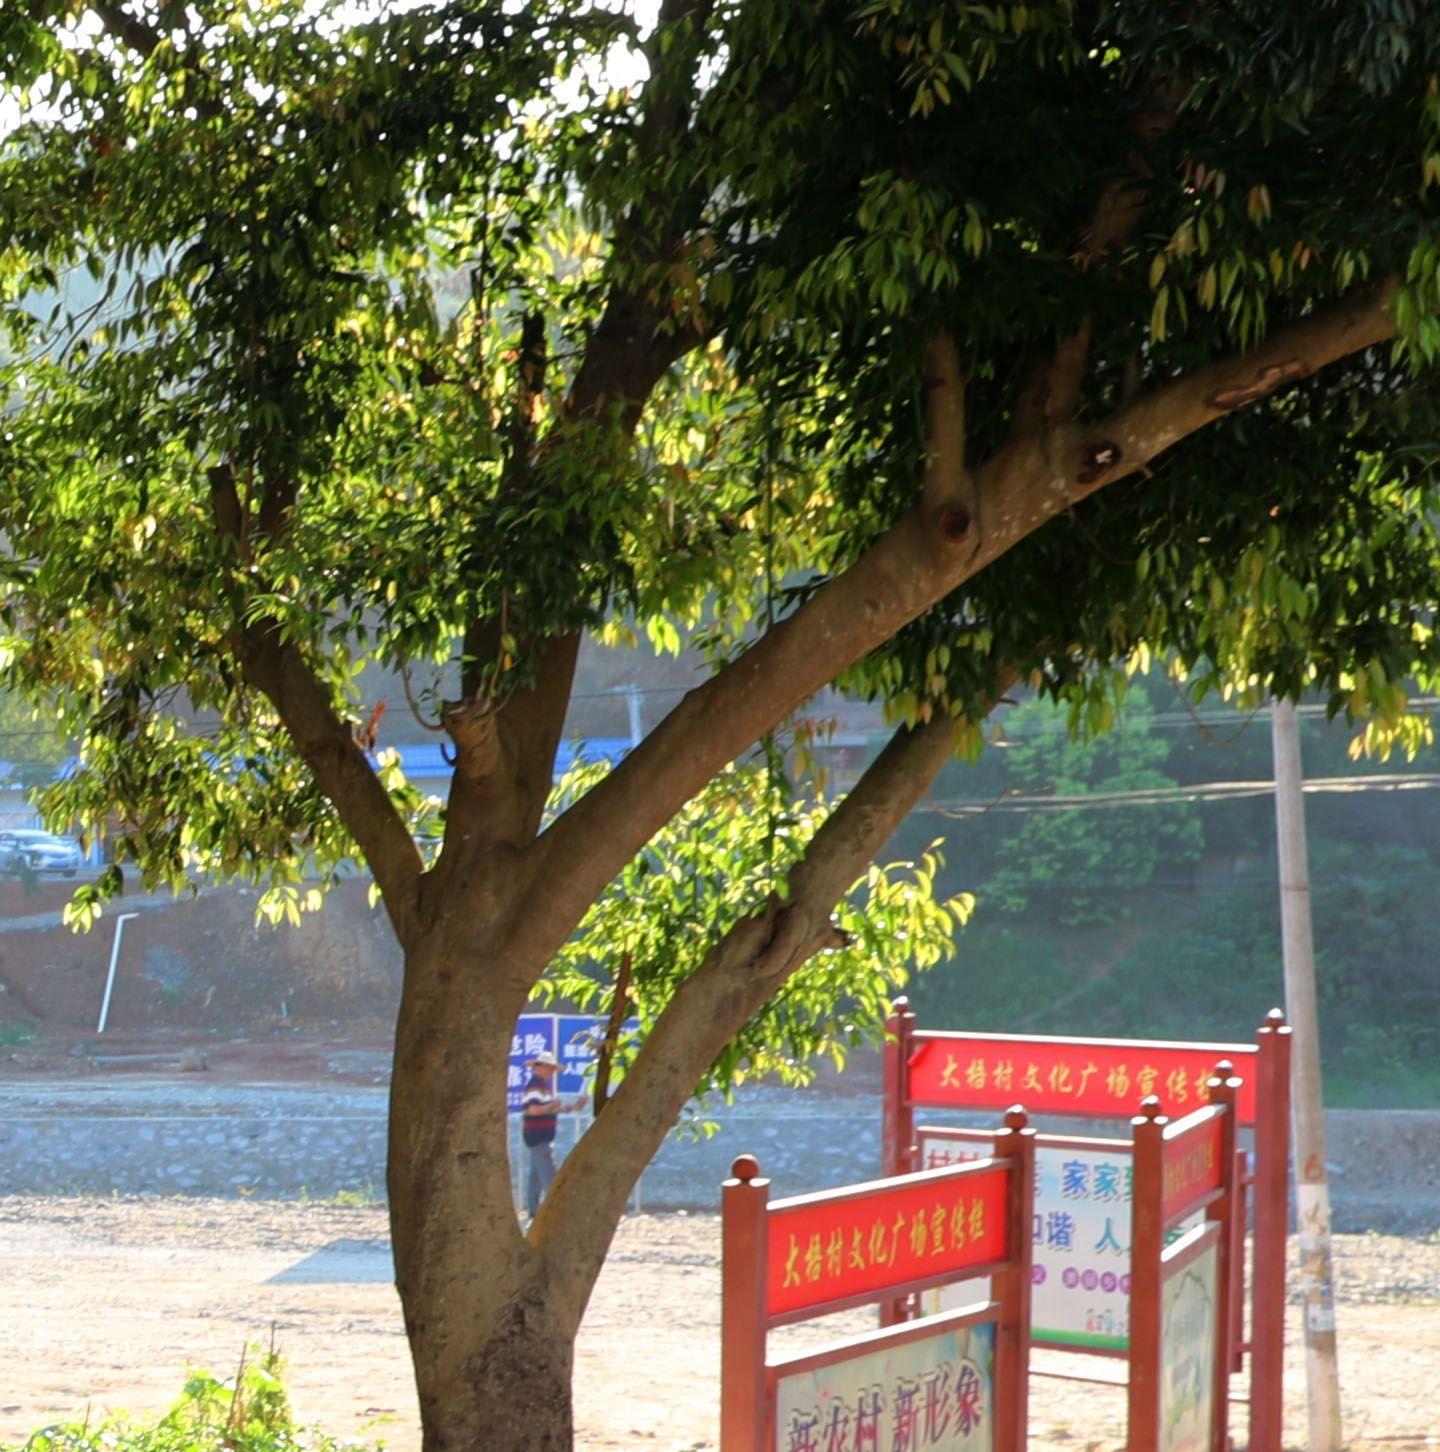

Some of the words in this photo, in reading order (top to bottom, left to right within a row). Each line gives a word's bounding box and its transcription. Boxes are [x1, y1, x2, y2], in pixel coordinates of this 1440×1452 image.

[783, 1197, 986, 1289] 大梧村文化广场宣传栏
